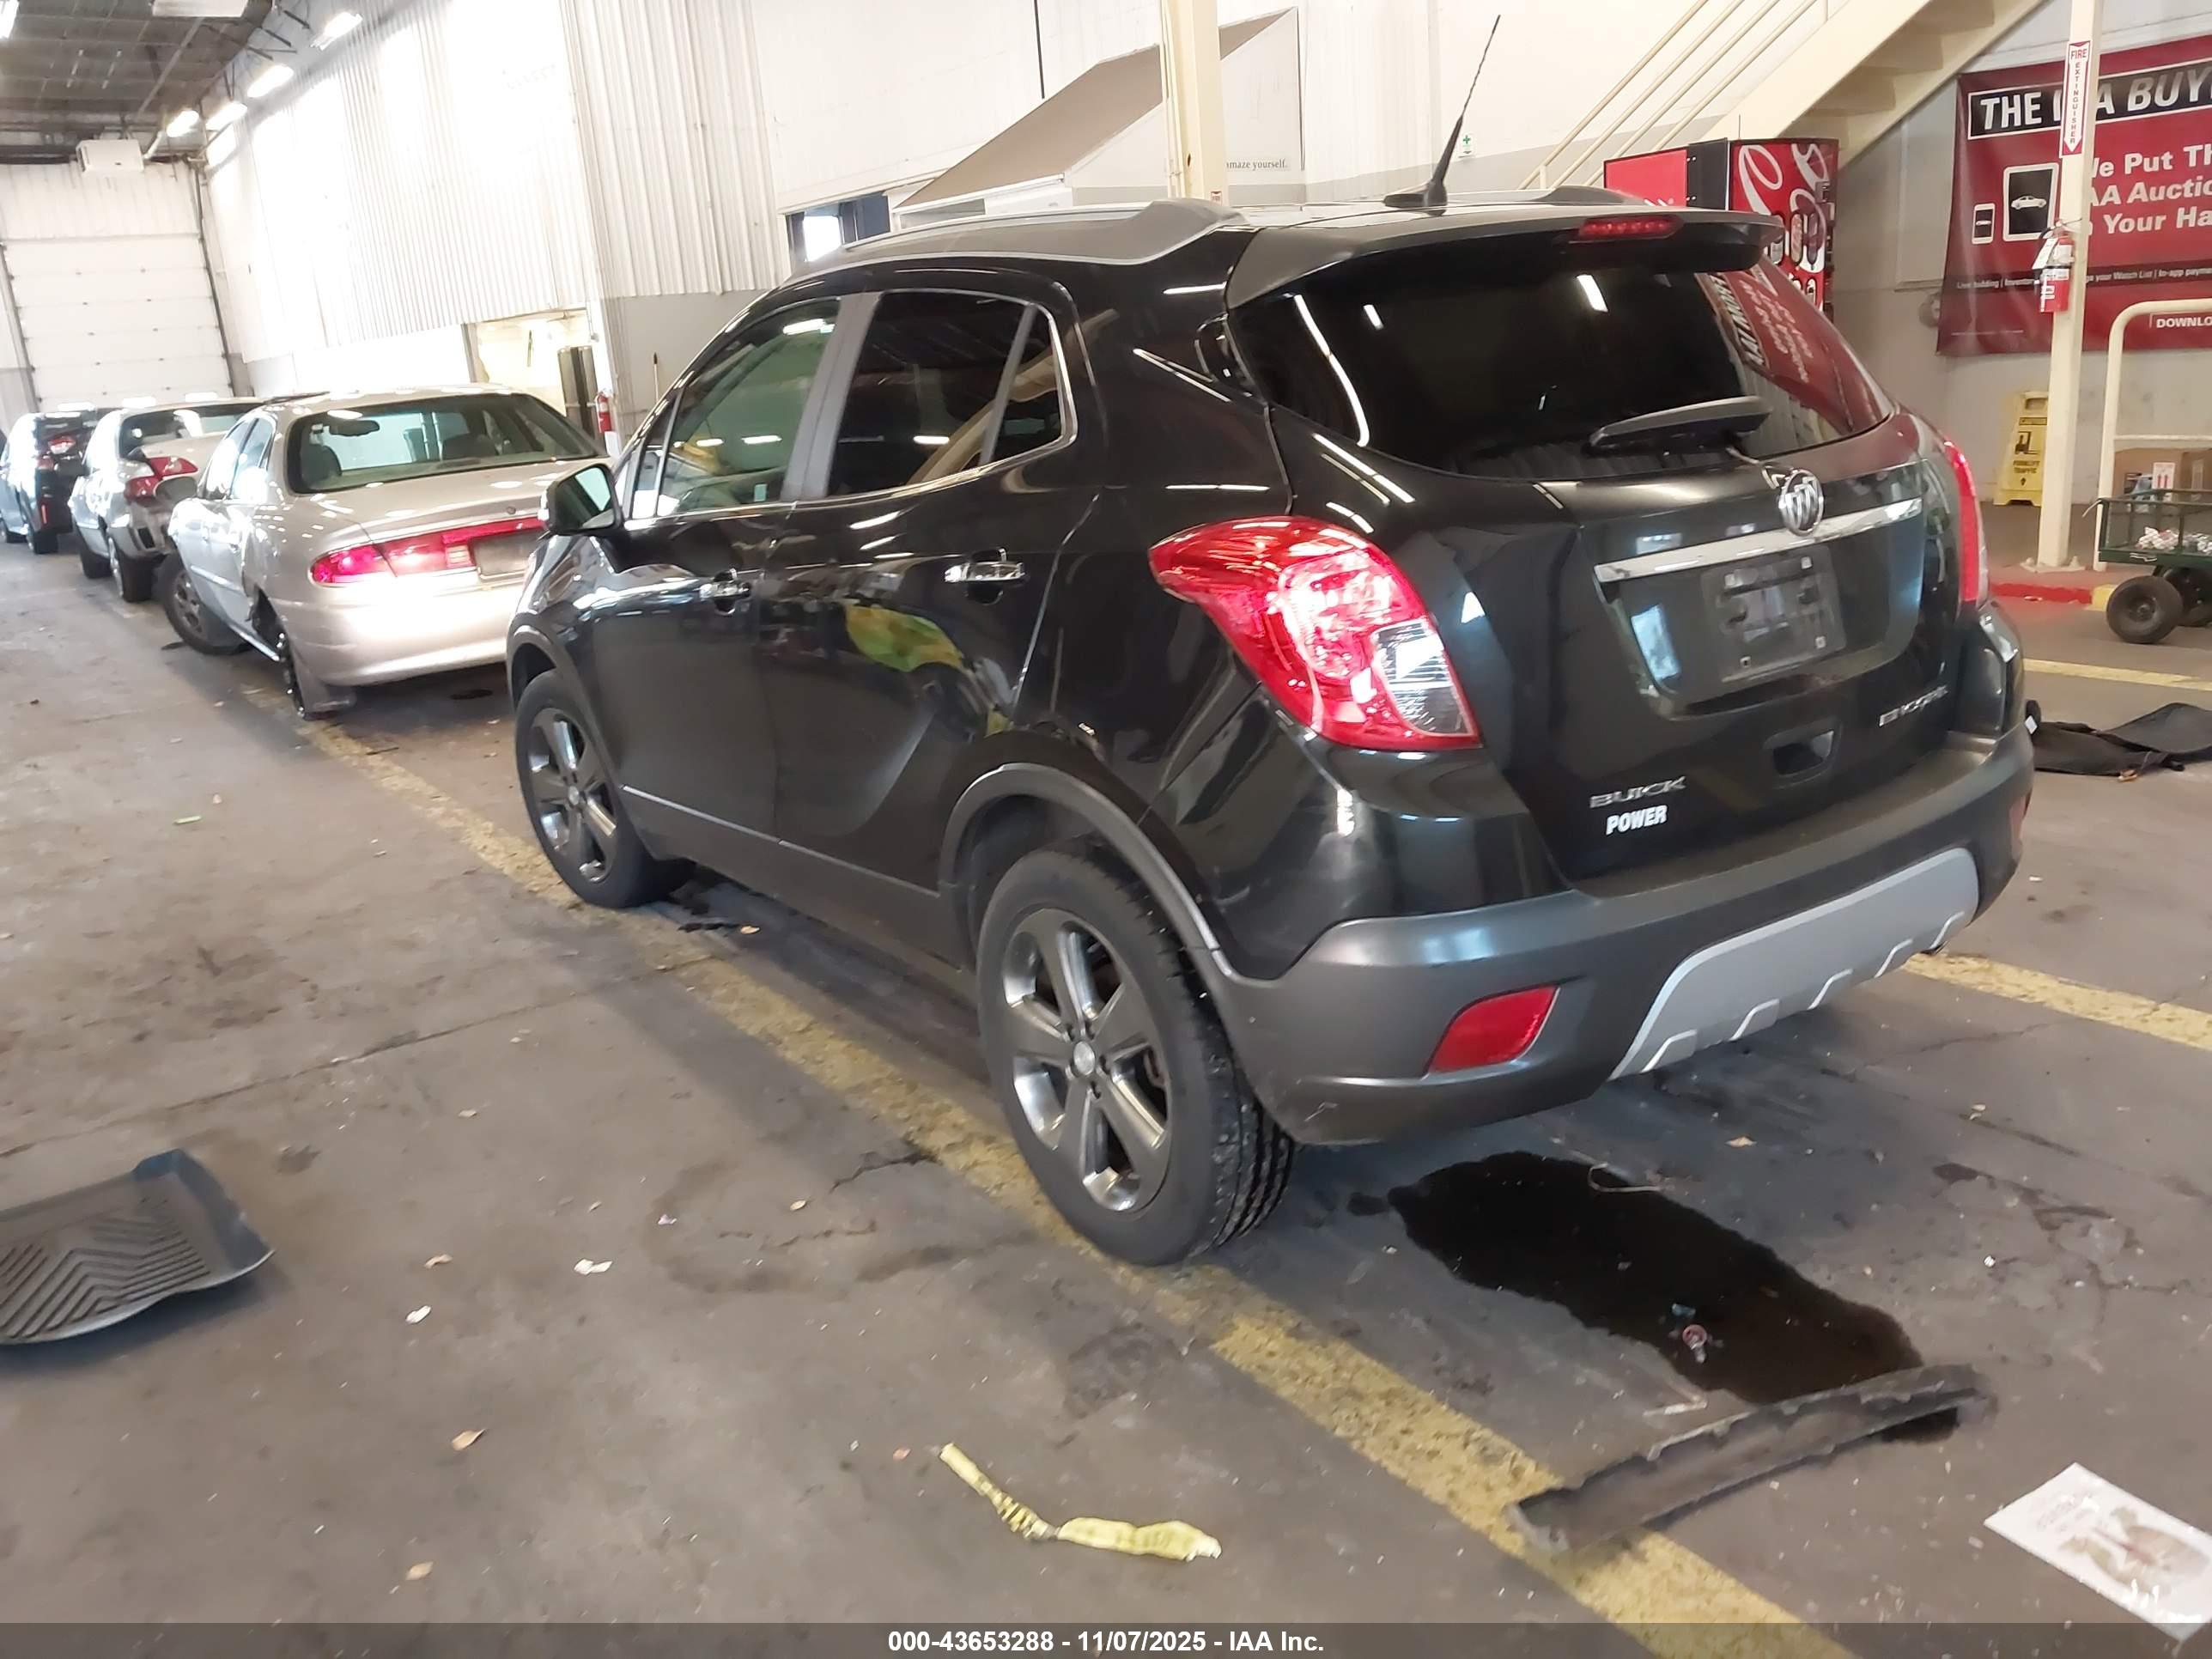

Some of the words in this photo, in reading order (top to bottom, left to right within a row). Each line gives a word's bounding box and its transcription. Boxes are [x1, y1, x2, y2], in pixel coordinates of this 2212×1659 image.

[2070, 49, 2087, 60] FIRE
[1980, 91, 2042, 130] THE
[2052, 82, 2115, 121] IA
[2069, 62, 2081, 144] EXTINGUISHER
[2124, 151, 2173, 175] Put
[2103, 213, 2166, 234] Your
[1590, 776, 1686, 808] BUICK
[1606, 805, 1668, 836] POWER
